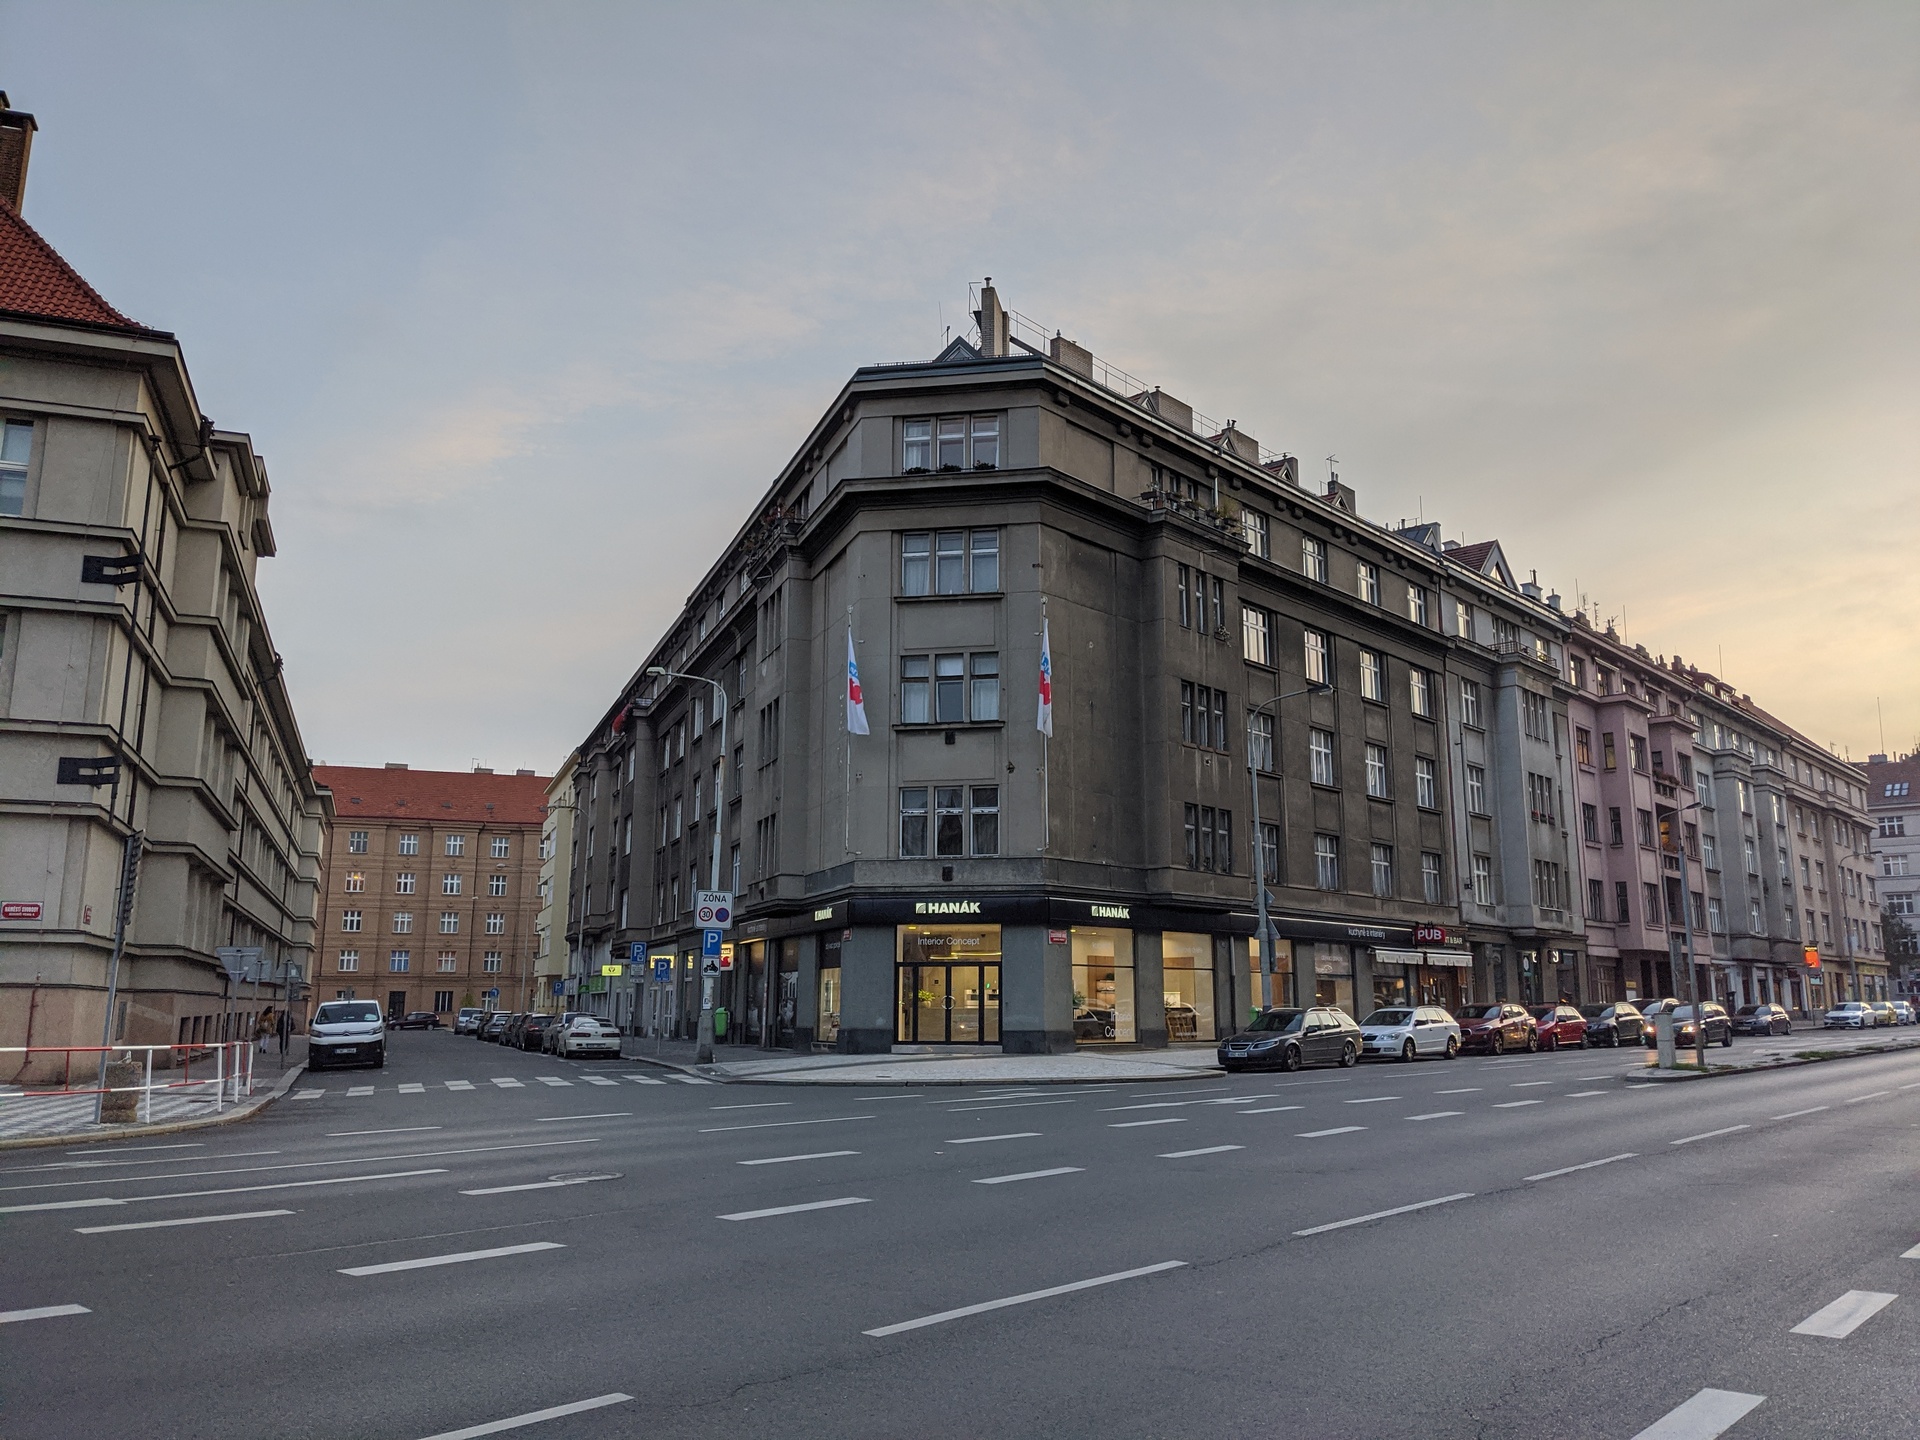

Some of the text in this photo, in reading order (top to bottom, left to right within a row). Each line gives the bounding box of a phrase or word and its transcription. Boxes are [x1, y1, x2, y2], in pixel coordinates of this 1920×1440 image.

[703, 892, 727, 903] ZÓNA
[928, 900, 981, 914] HANÁK
[1099, 905, 1130, 919] HANÁK
[701, 910, 711, 919] 30
[1417, 928, 1442, 940] PUB
[707, 933, 718, 948] P
[917, 936, 980, 947] Interior Concept
[634, 944, 643, 957] P
[658, 961, 668, 975] P
[555, 982, 562, 992] P
